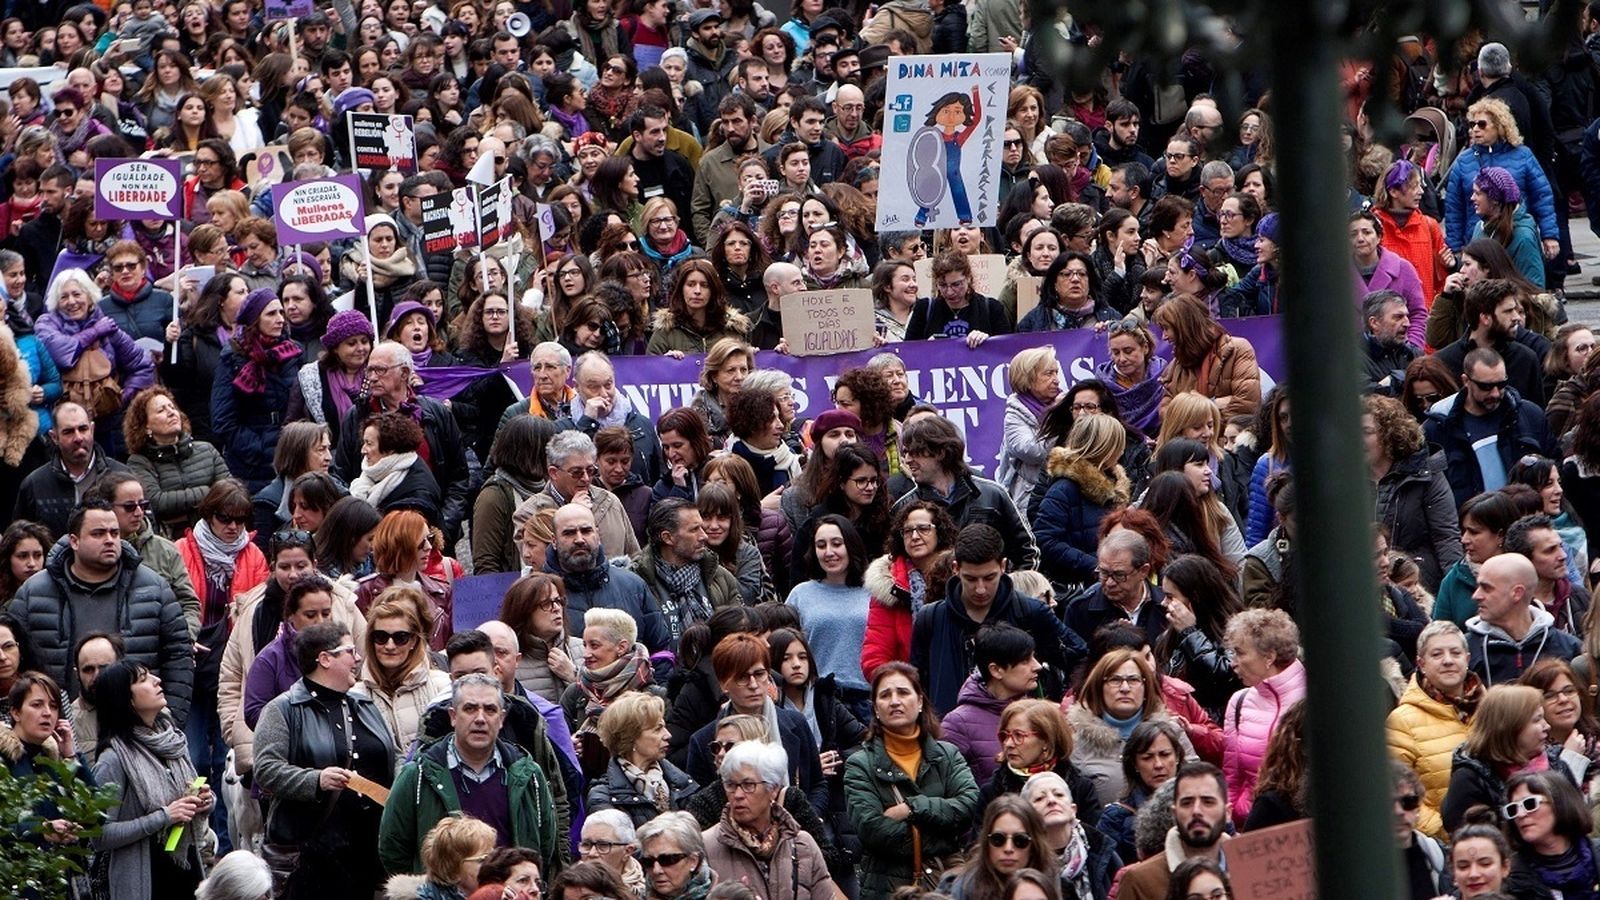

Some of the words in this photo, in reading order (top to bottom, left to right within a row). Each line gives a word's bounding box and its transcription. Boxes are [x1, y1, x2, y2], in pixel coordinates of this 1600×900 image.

[898, 62, 934, 79] DINA
[940, 60, 981, 78] MITA
[129, 163, 148, 172] SEN
[112, 173, 165, 181] IGUALDADE
[108, 190, 167, 202] LIBERDADE
[294, 189, 307, 197] NIN
[307, 185, 337, 195] CRIADAS
[292, 198, 305, 206] NIN
[306, 192, 341, 204] ESCRAVAS
[297, 203, 345, 216] Mulleres
[291, 210, 353, 227] LIBERADAS
[802, 295, 833, 307] HOXE
[842, 294, 850, 303] E
[807, 307, 839, 319] TODOS
[843, 306, 856, 316] OS
[804, 328, 859, 351] IGUALDADE
